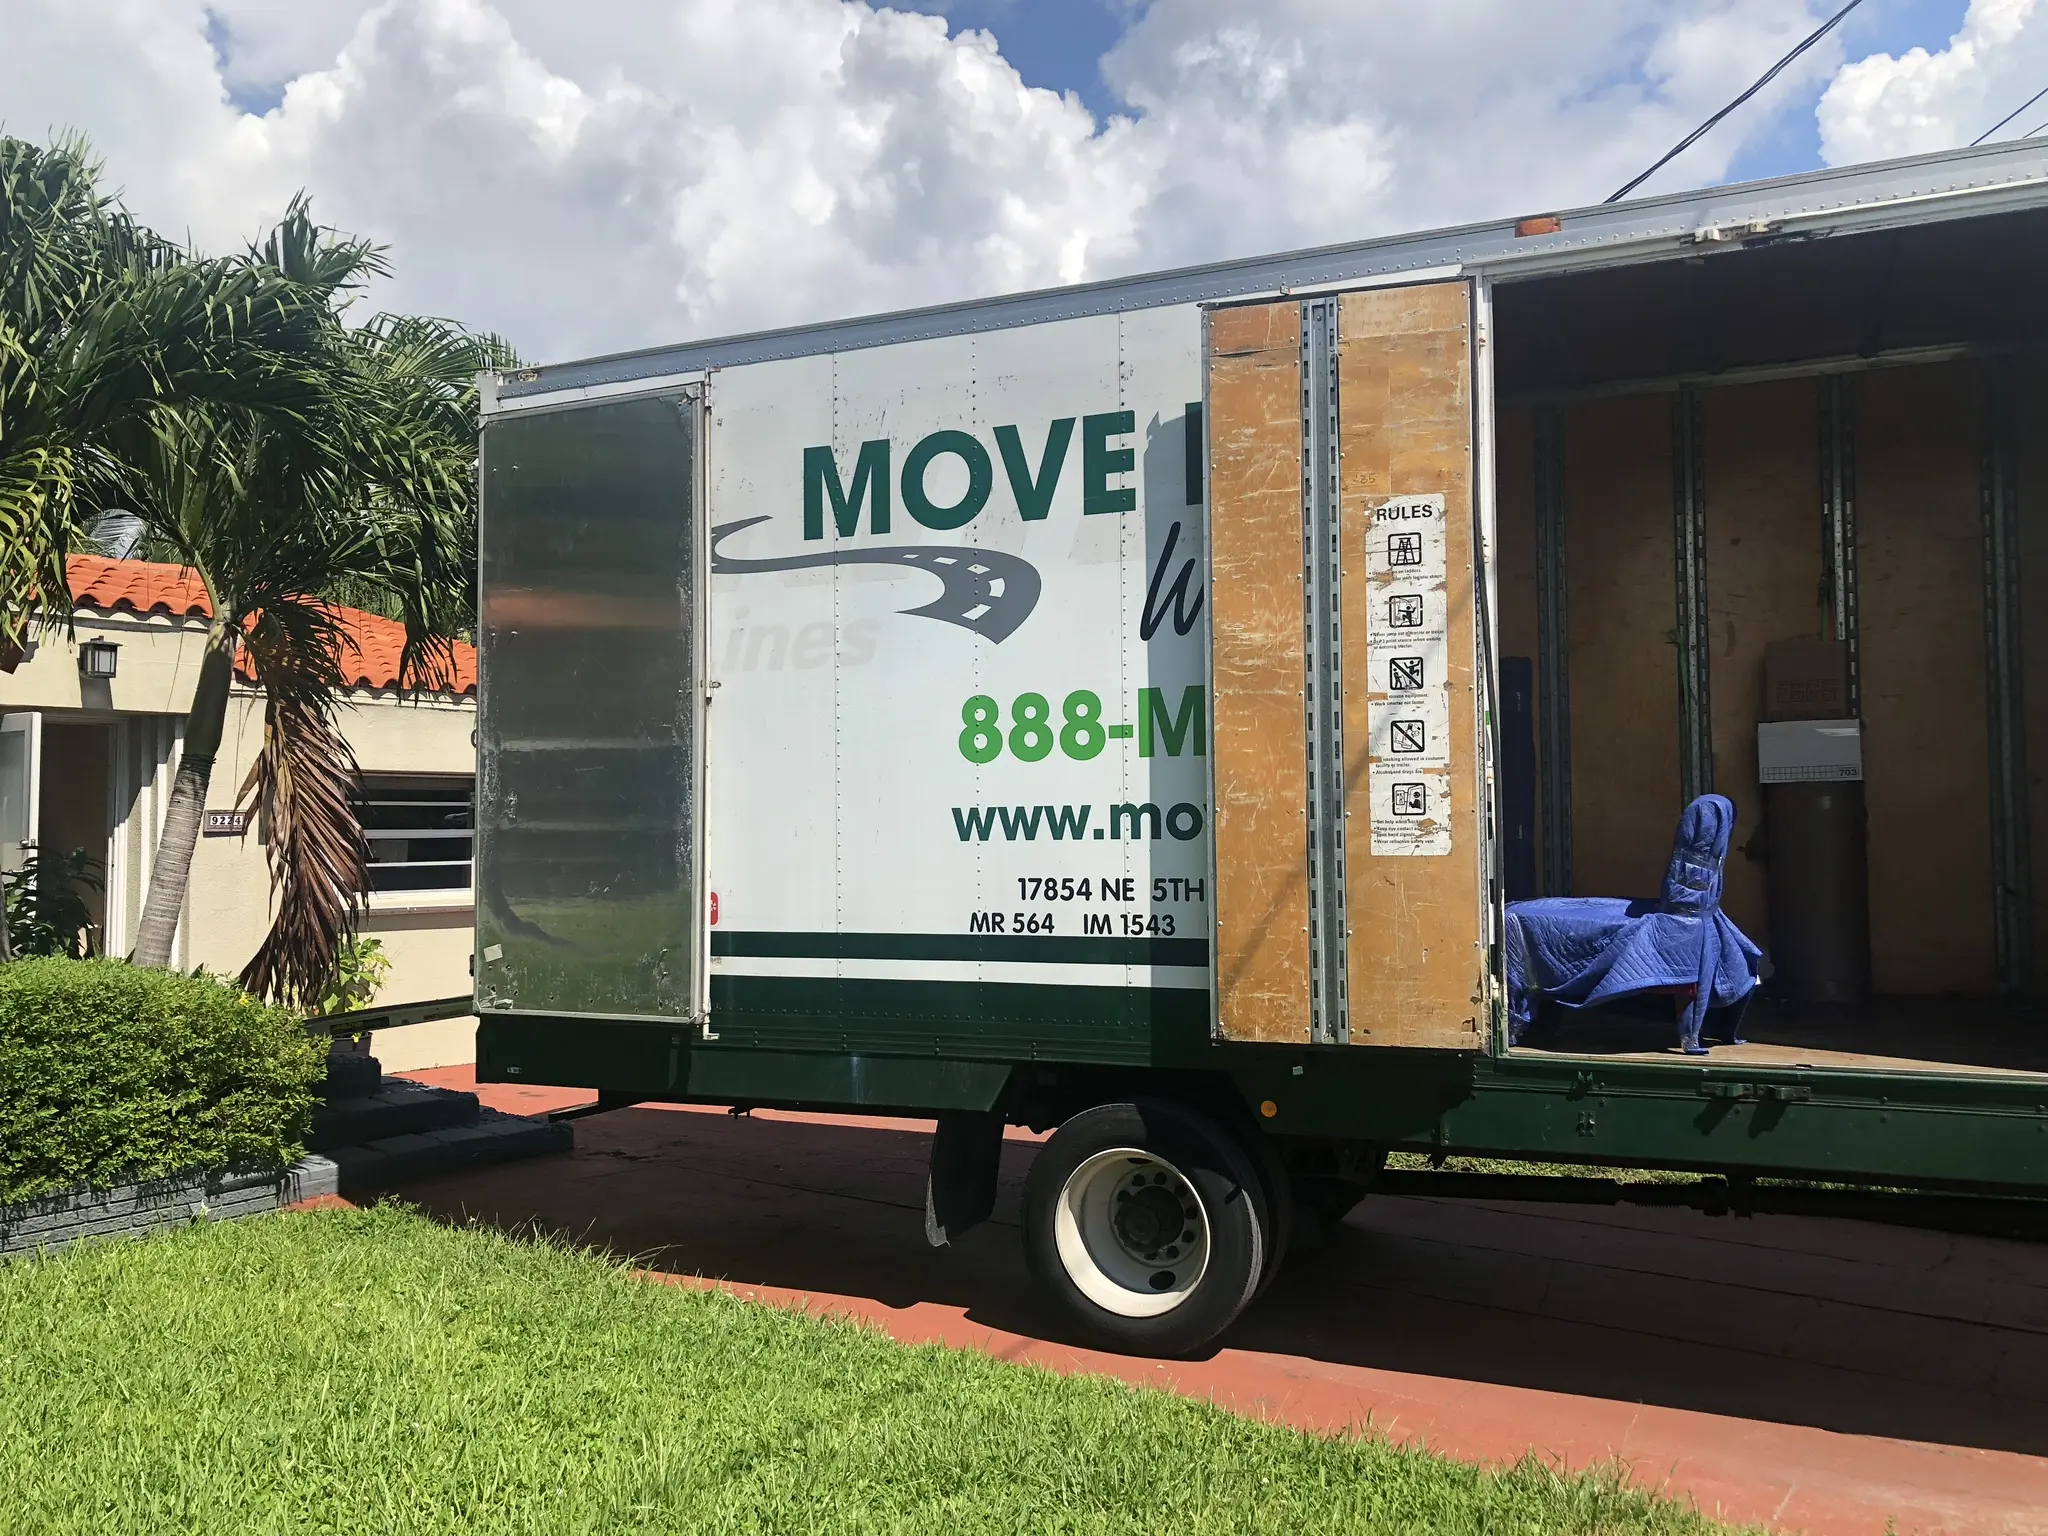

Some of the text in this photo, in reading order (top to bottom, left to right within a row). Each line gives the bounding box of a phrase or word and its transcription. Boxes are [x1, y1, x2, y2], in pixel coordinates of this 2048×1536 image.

[803, 410, 1136, 541] MOVE
[1376, 504, 1433, 521] RULES
[712, 606, 883, 673] ines
[958, 684, 1206, 764] 888-M
[951, 801, 1208, 842] www.mo
[1017, 877, 1205, 902] 17854 NE 5TH
[969, 912, 1176, 936] MR 564 IM 1543
